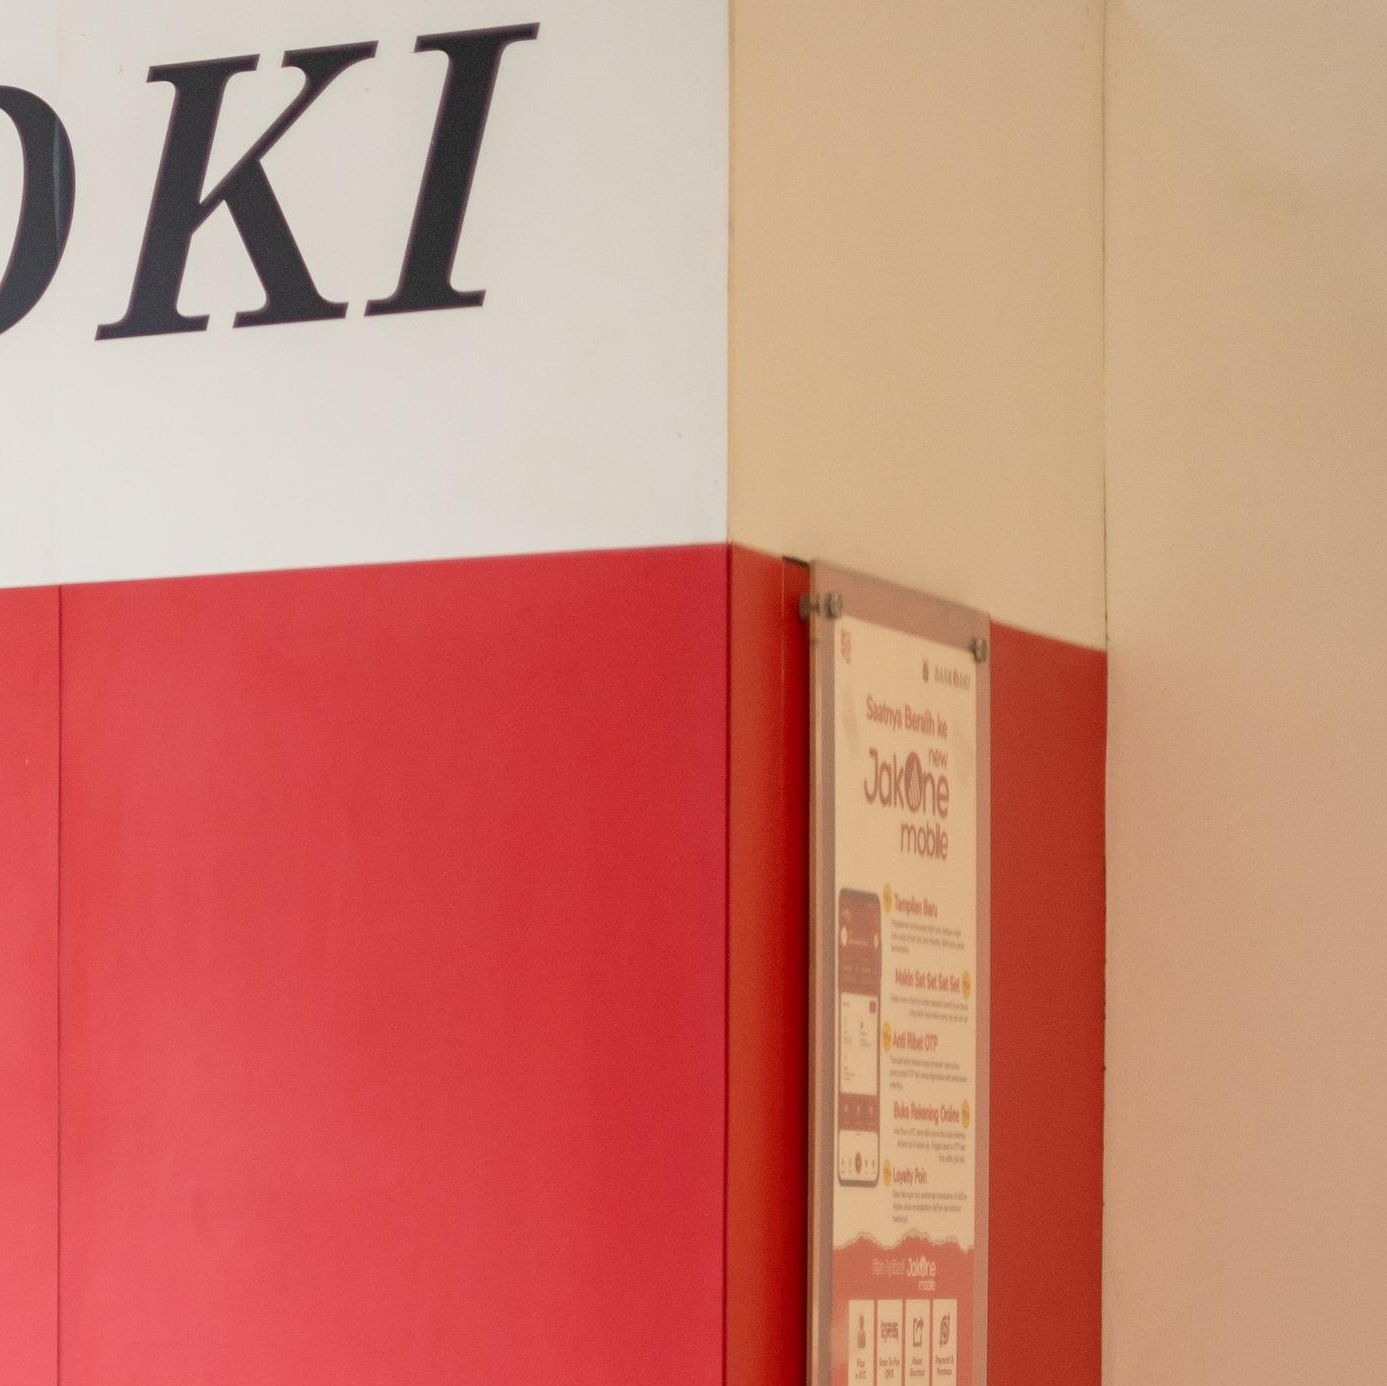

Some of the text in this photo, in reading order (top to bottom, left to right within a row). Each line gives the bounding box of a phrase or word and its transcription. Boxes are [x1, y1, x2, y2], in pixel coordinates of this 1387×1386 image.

[904, 704, 935, 737] Beralih
[937, 712, 948, 740] ke
[928, 747, 948, 768] new
[864, 749, 949, 819] JakOne
[900, 822, 948, 861] mobile
